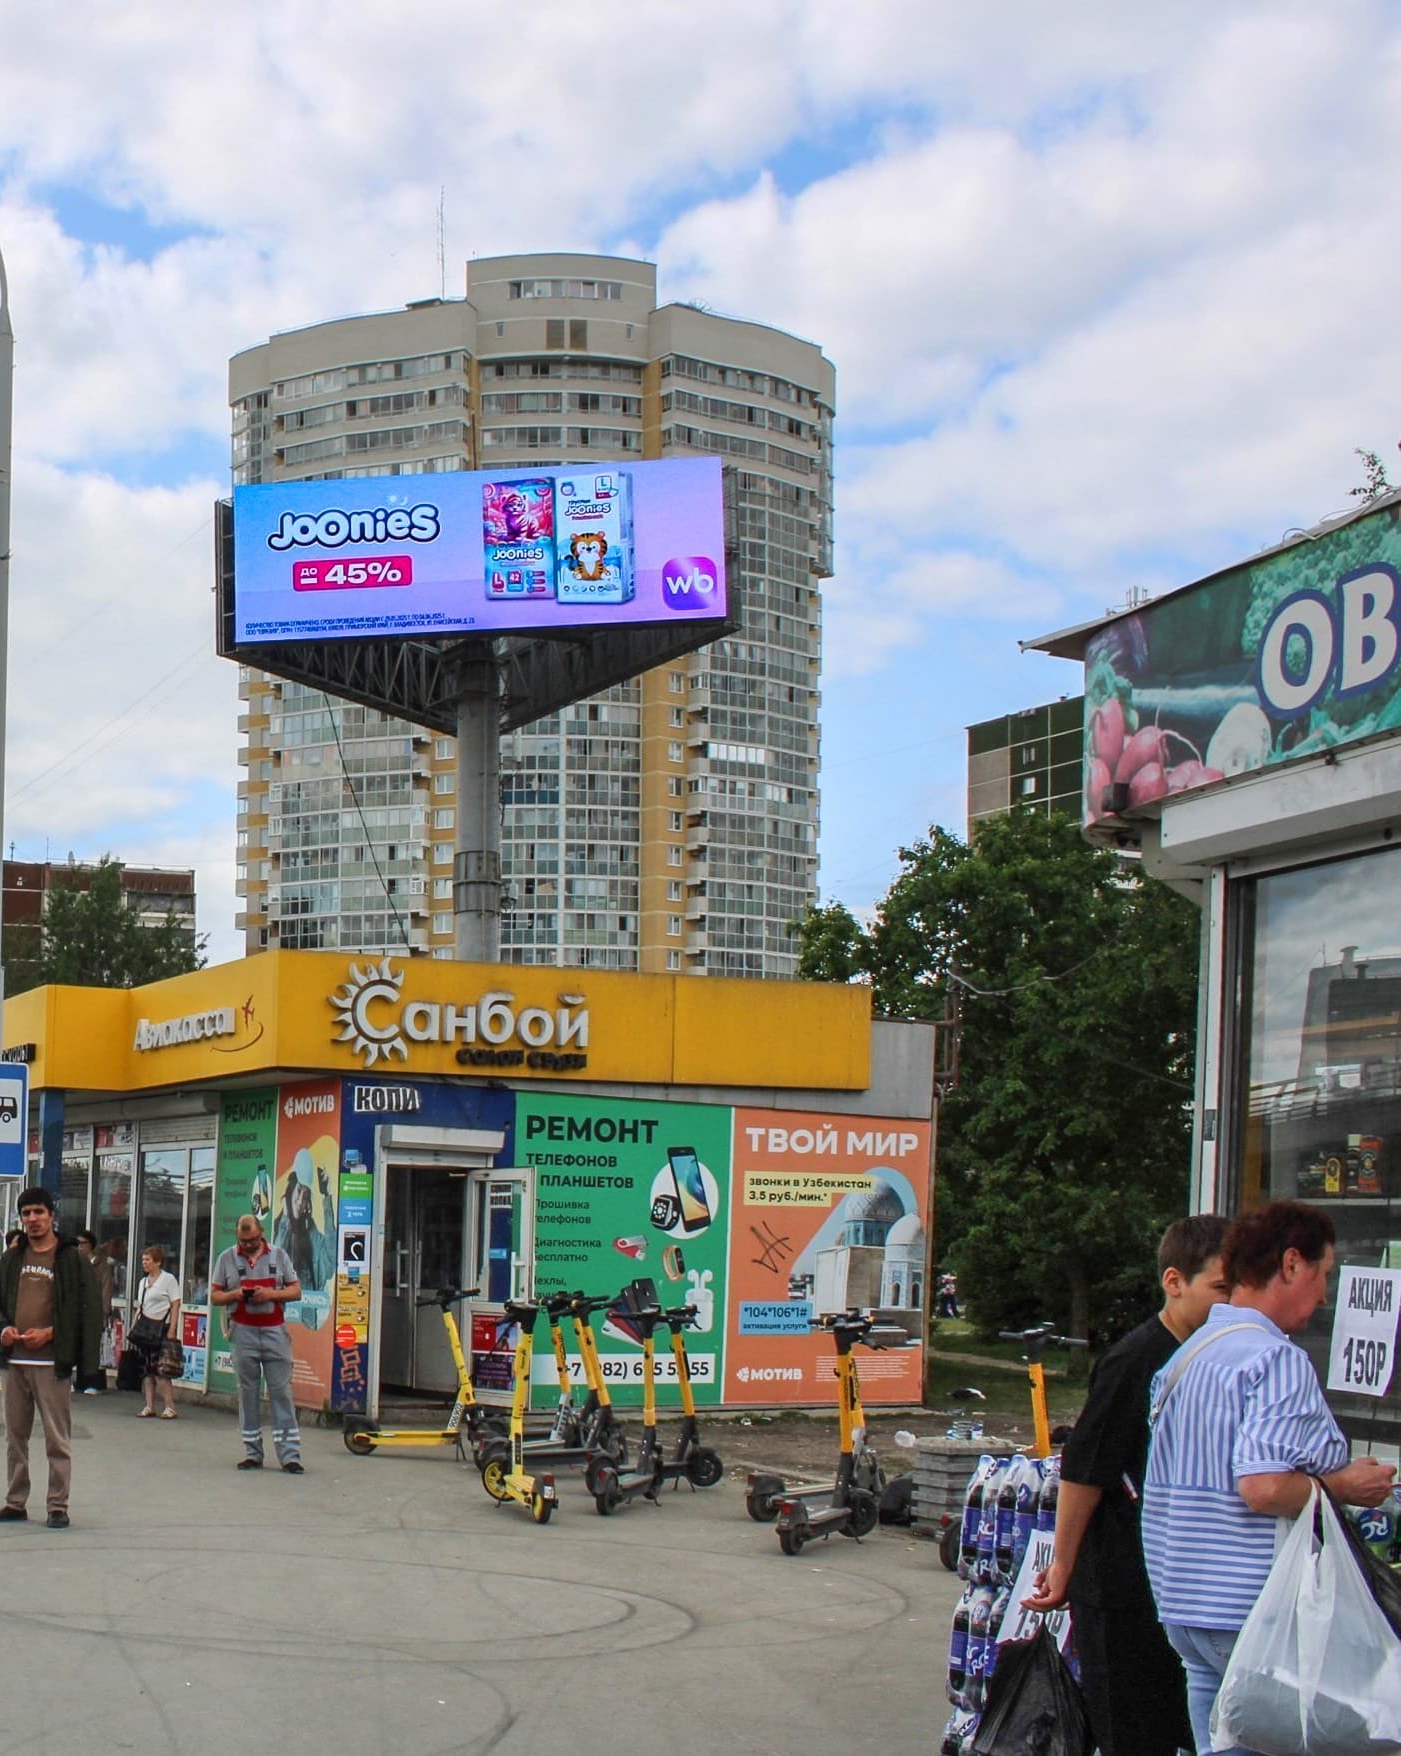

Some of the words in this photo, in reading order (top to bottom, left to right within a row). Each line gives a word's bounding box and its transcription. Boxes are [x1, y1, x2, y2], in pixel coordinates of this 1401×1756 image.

[353, 982, 589, 1048] Санбой
[132, 1006, 236, 1052] Авиакасса
[224, 1100, 274, 1123] РЕМОНТ
[294, 1094, 335, 1116] МОТИВ
[526, 1115, 659, 1144] РЕМОНТ
[745, 1123, 838, 1155] ТВОЙ
[846, 1131, 919, 1157] МИР
[526, 1152, 617, 1168] ТЕЛЕФОНОВ
[540, 1174, 634, 1189] ПЛАНШЕТОВ
[749, 1177, 791, 1187] звонки
[792, 1179, 800, 1187] в
[802, 1177, 871, 1189] Узбекистан
[1348, 1276, 1393, 1318] АКЦИЯ
[750, 1367, 803, 1381] МОТИВ
[1342, 1336, 1387, 1387] 150Р
